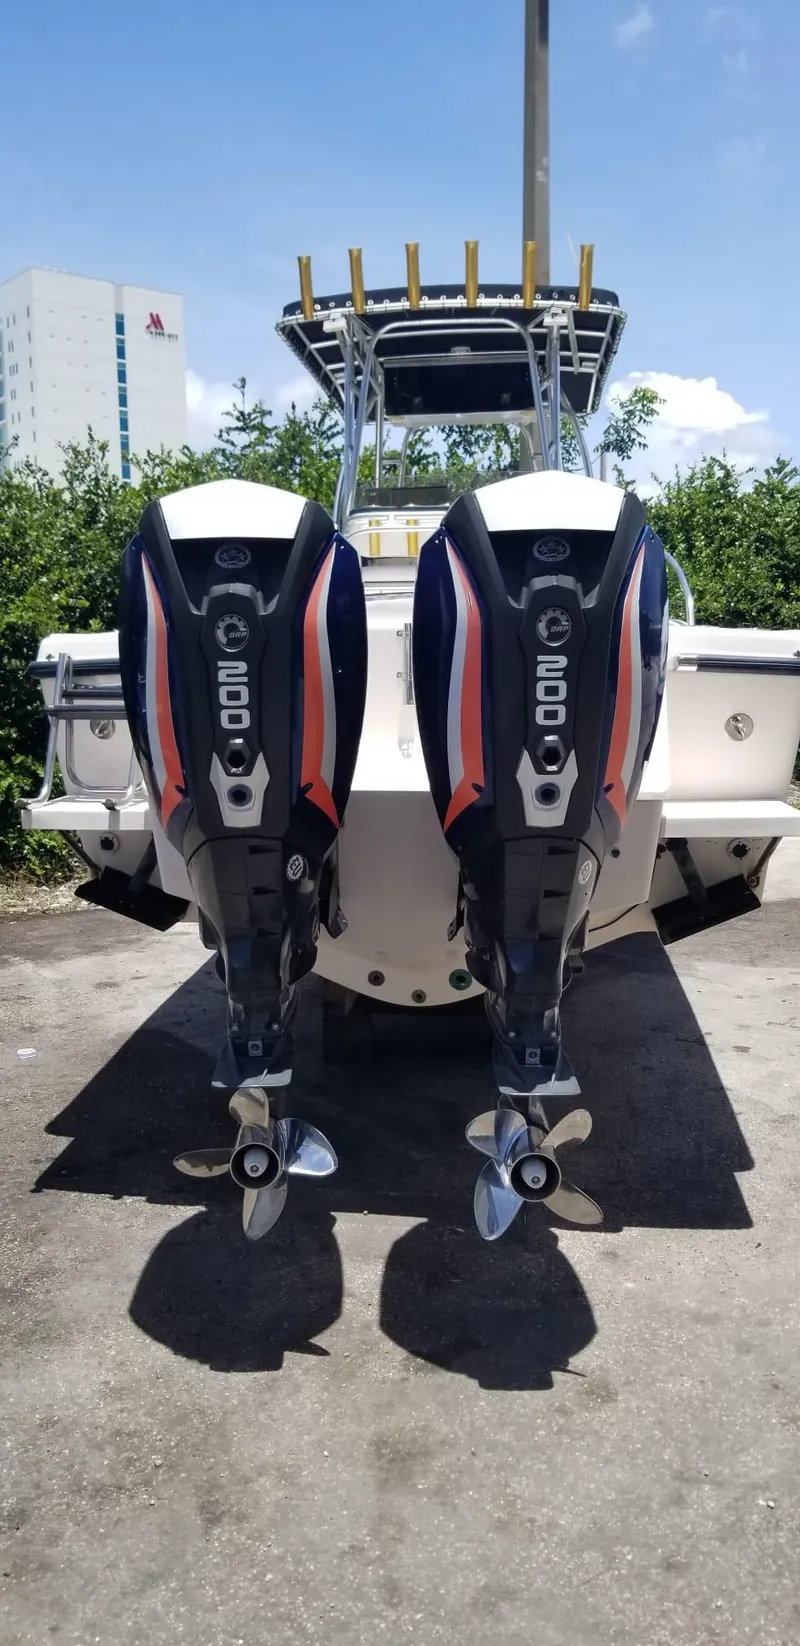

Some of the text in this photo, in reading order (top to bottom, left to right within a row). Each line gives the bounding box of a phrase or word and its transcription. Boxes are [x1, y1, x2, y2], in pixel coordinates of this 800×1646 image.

[229, 631, 247, 639] BRP
[550, 625, 569, 633] BRP
[217, 661, 251, 729] 200
[536, 656, 568, 725] 200
